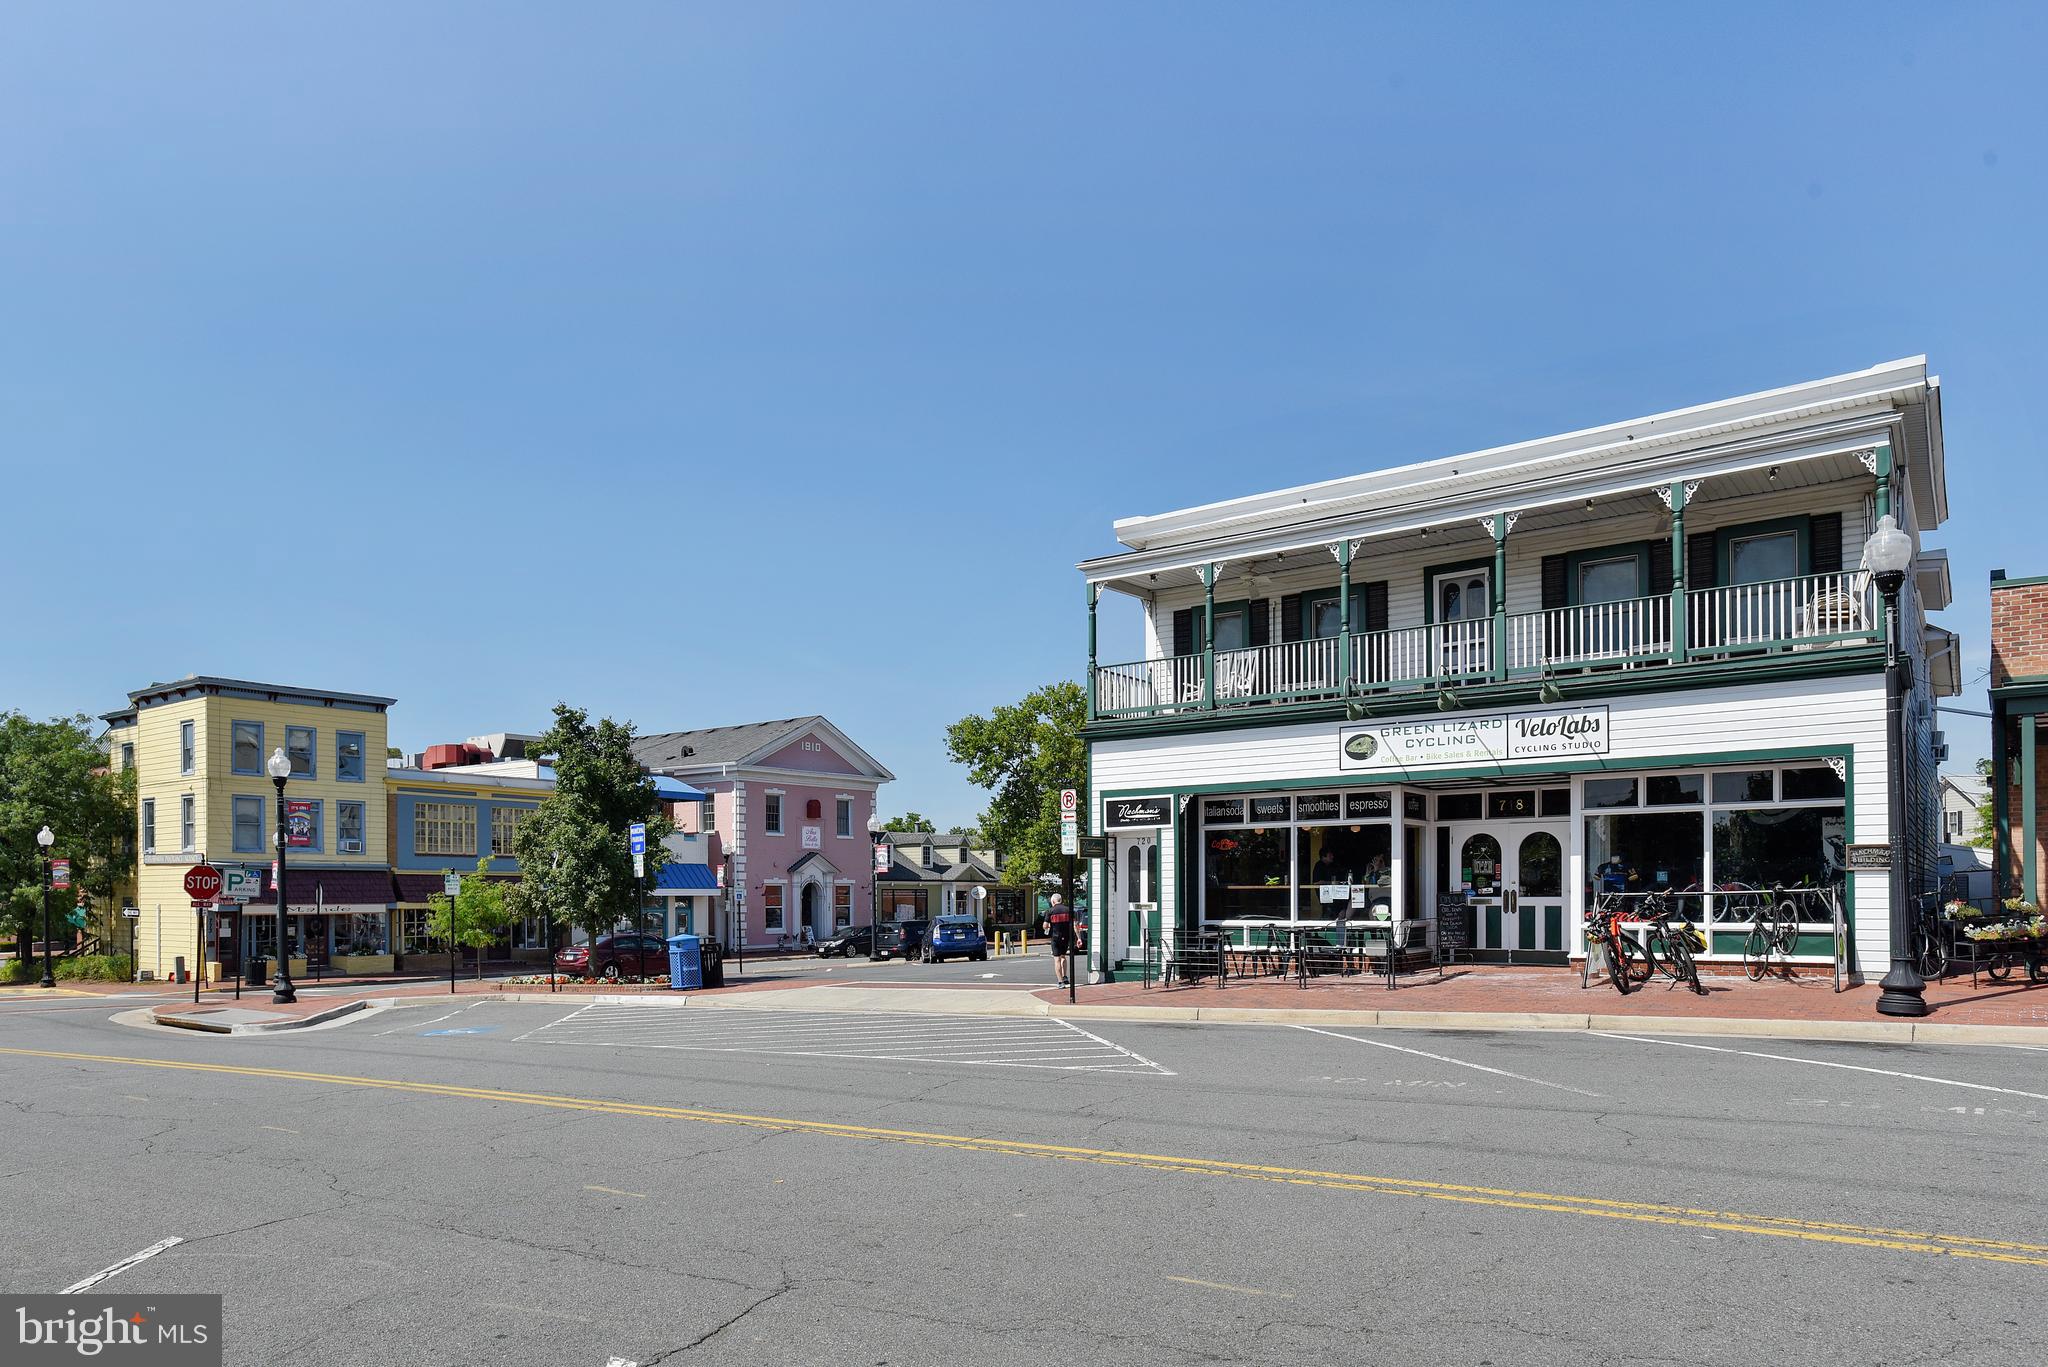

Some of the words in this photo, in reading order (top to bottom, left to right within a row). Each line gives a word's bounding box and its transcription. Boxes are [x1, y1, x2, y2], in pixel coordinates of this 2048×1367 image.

[1381, 724, 1435, 738] GREEN
[1443, 719, 1503, 732] LIZARD
[1515, 715, 1600, 740] VeloLabs
[801, 741, 821, 752] 1910
[1405, 734, 1476, 749] CYCLING
[1515, 743, 1557, 753] CYCLING
[1562, 740, 1601, 750] STUDIO
[1381, 755, 1403, 763] Coffee
[1405, 754, 1418, 762] Bar
[1426, 753, 1441, 761] Bike
[1444, 751, 1465, 759] Sales
[1474, 748, 1503, 757] Rentals
[1256, 804, 1284, 815] sweets
[1298, 799, 1339, 813] smoothies
[1349, 799, 1389, 812] espresso
[1136, 837, 1151, 845] 720
[186, 875, 219, 890] STOP
